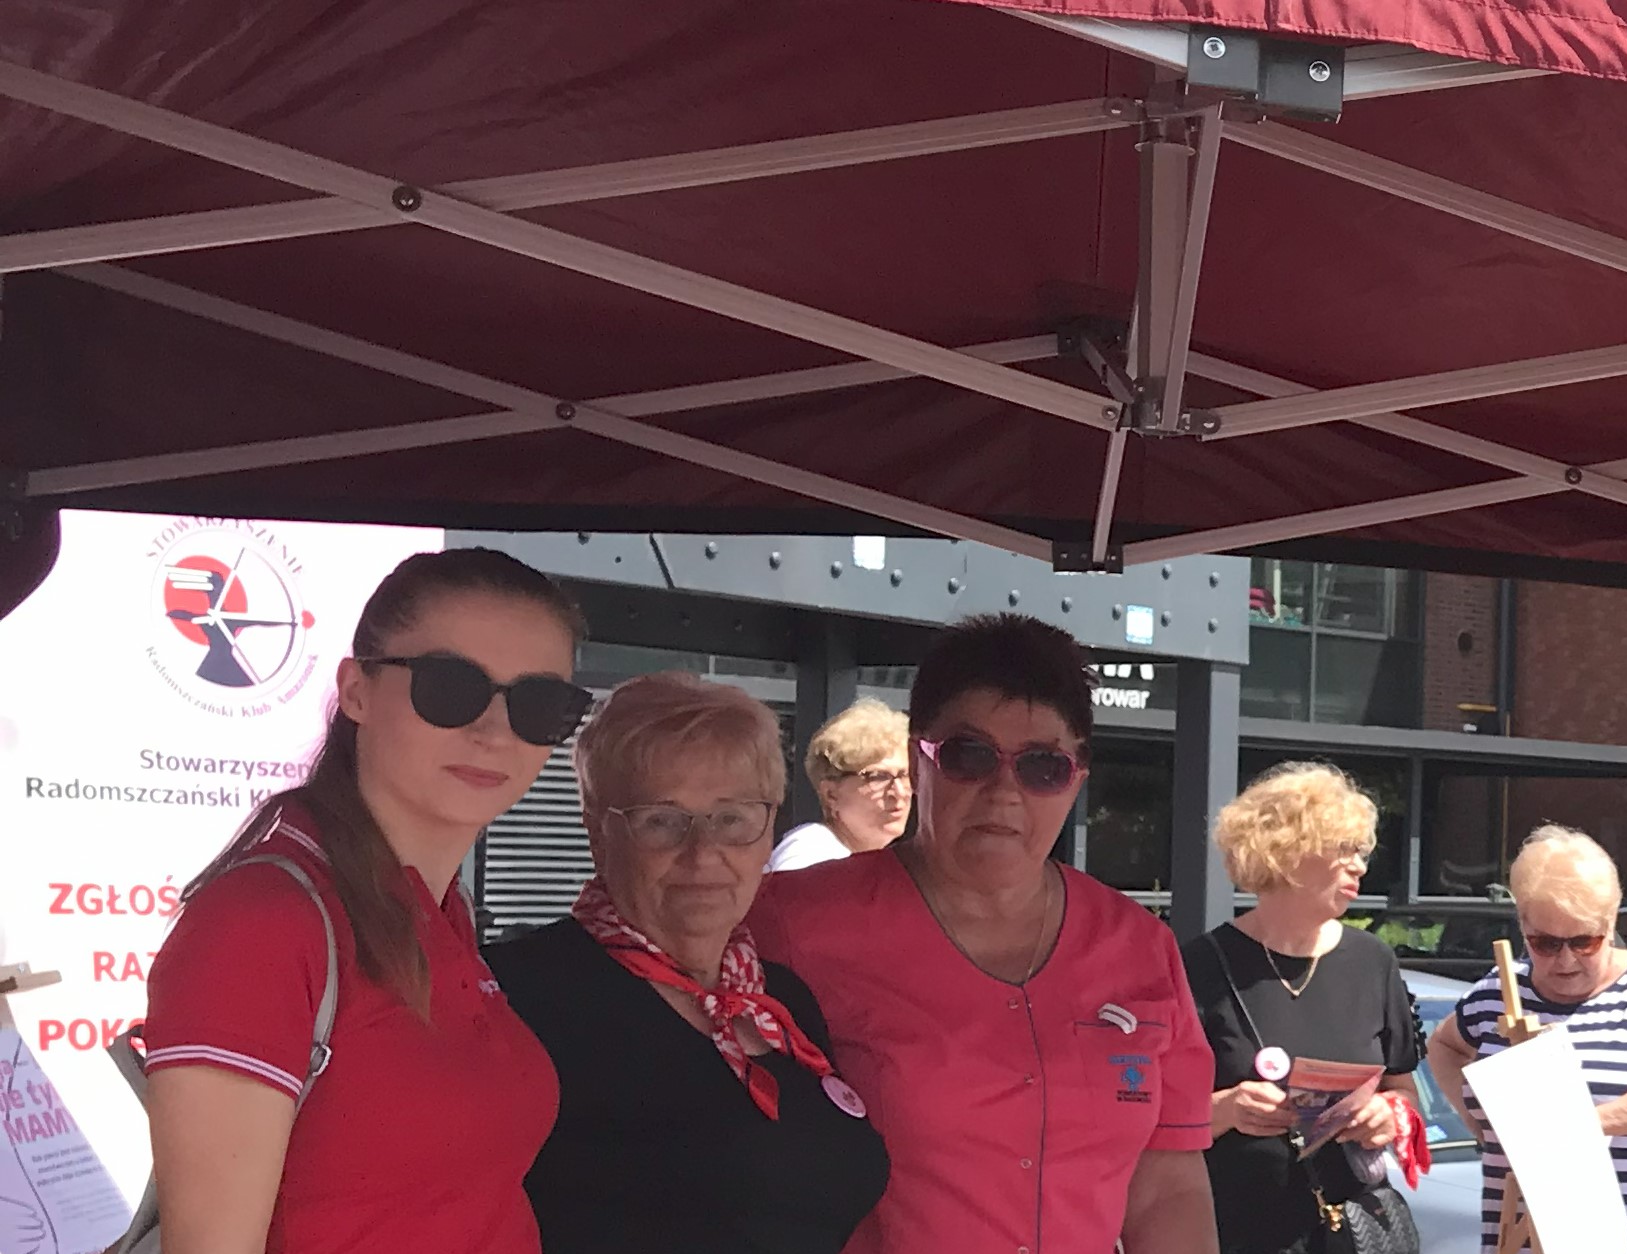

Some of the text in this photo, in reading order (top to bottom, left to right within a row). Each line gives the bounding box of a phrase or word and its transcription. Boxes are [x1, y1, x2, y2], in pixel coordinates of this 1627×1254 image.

[241, 703, 272, 718] Klub
[1090, 686, 1151, 710] rowar
[25, 776, 241, 808] Radomszczański
[48, 874, 181, 917] ZGŁOŚ
